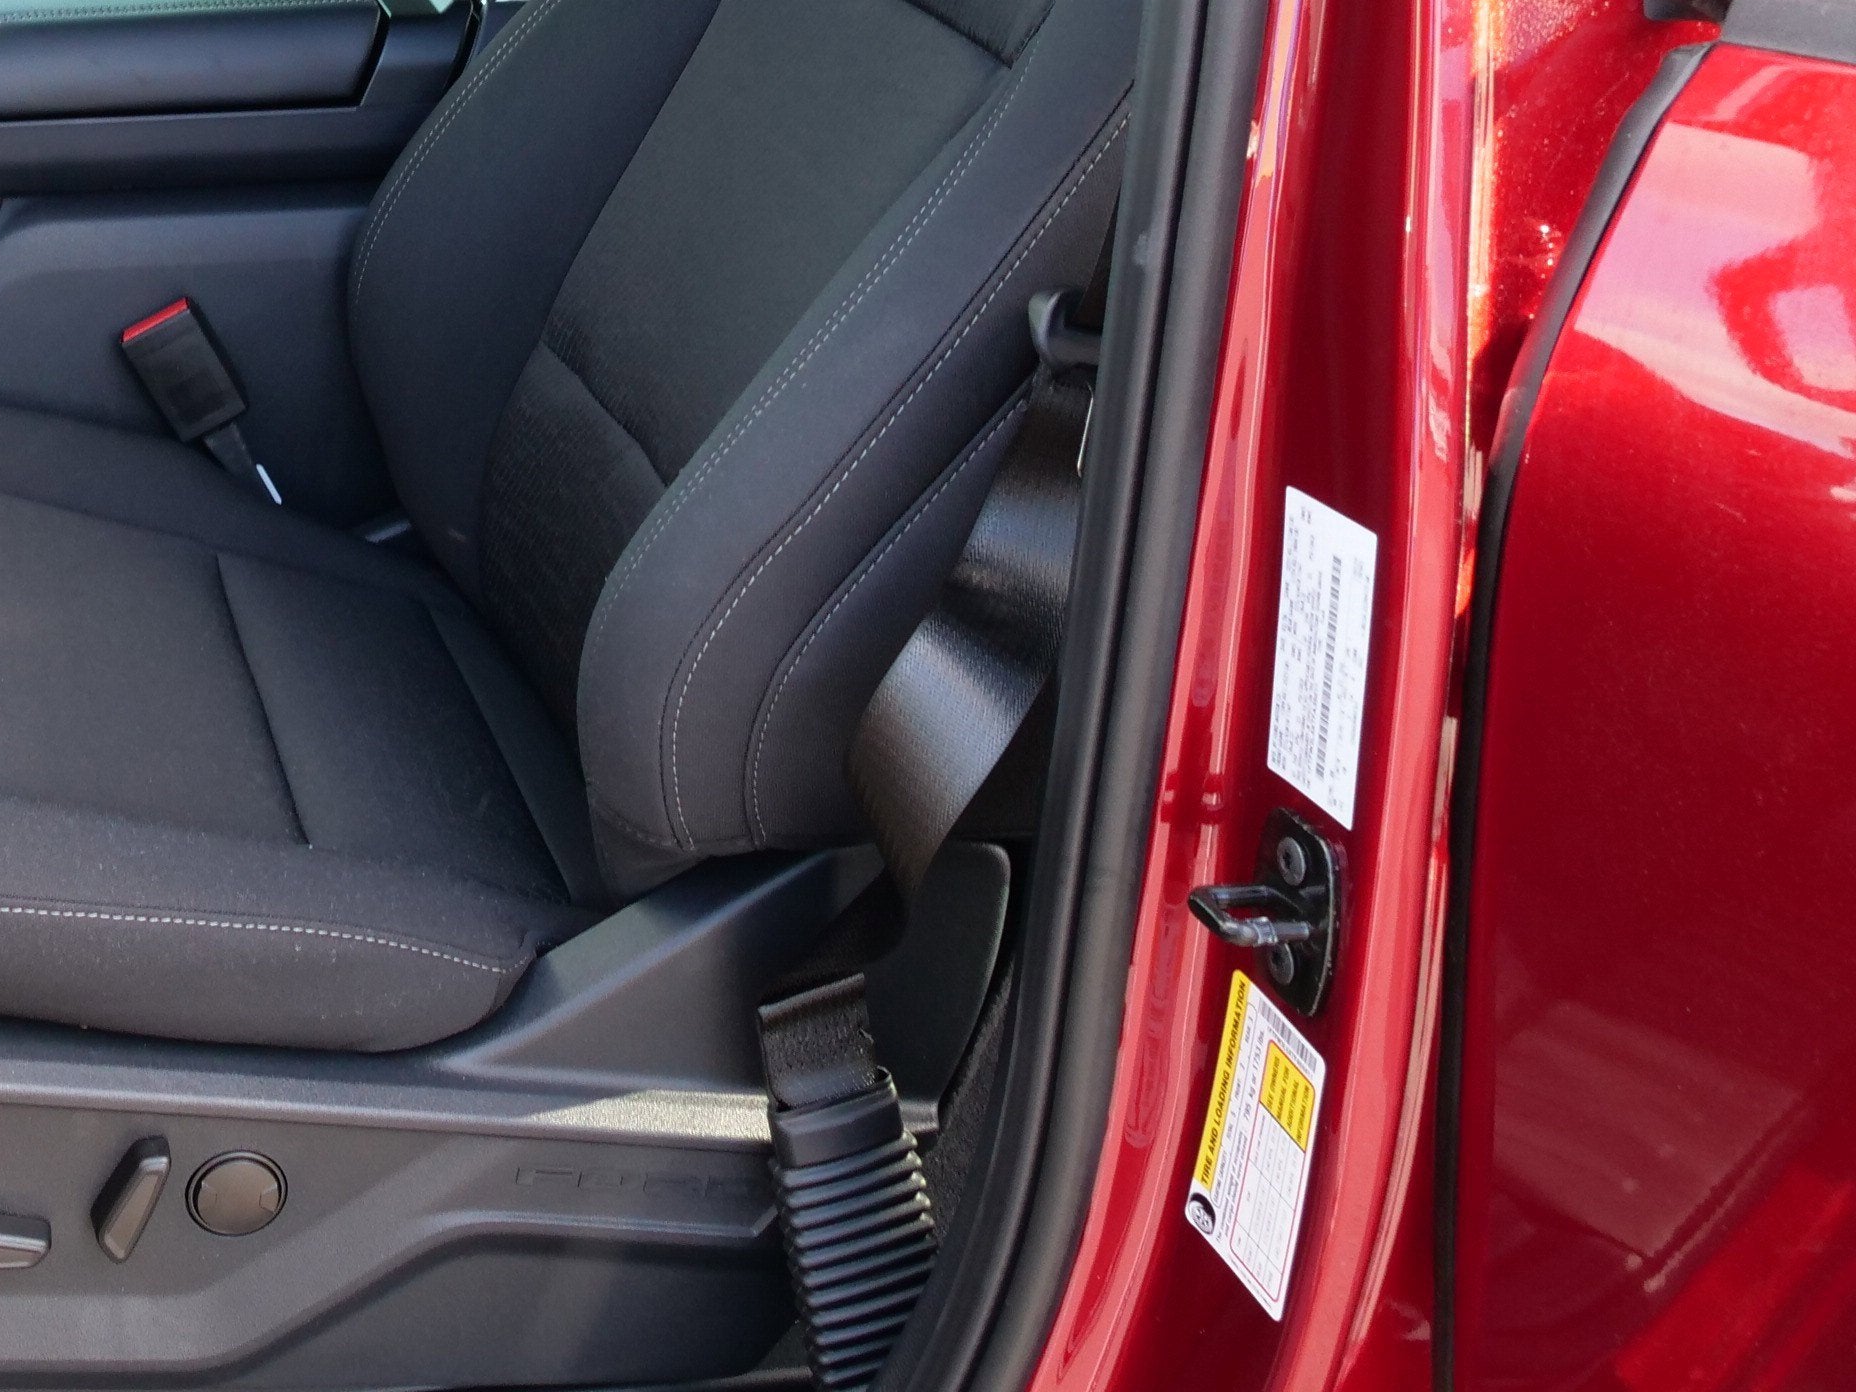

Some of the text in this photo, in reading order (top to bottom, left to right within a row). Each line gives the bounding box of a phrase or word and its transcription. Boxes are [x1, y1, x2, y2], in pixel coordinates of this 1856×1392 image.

[1201, 980, 1245, 1183] TIRE AND LOADING INFORMATION
[1296, 1085, 1309, 1142] INFORMATION
